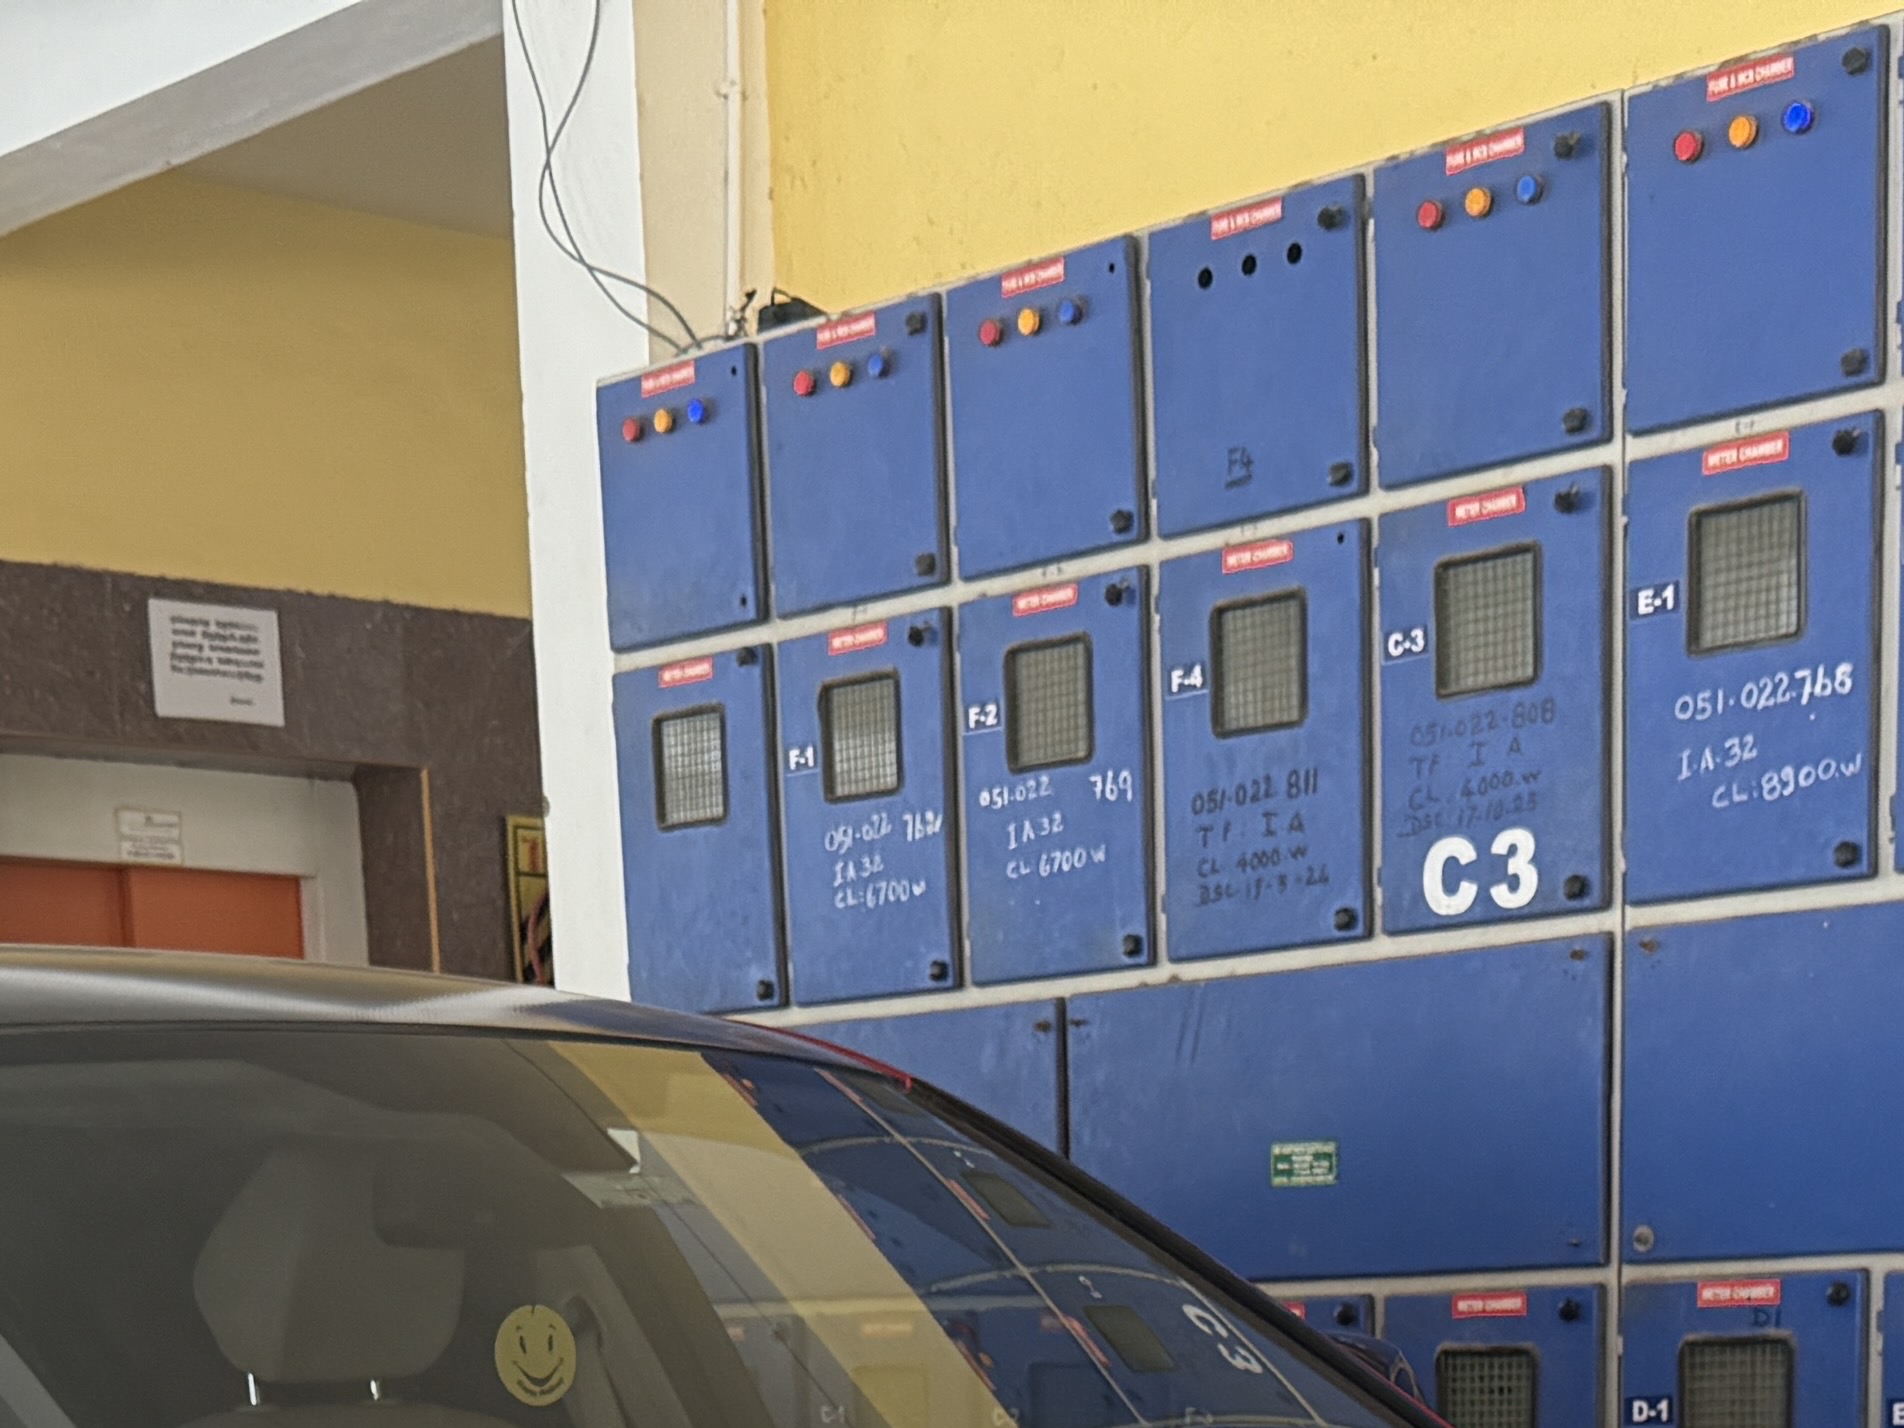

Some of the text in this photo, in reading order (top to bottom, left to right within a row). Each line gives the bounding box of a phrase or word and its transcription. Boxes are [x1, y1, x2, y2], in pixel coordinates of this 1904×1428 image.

[1707, 437, 1785, 468] METER CHAMBER
[1637, 583, 1675, 615] E-1
[1387, 628, 1425, 656] C-3
[1170, 665, 1203, 693] F-4
[968, 704, 999, 729] F-2
[789, 747, 815, 770] F-1
[1088, 768, 1133, 803] 769
[1631, 1399, 1671, 1423] D-1
